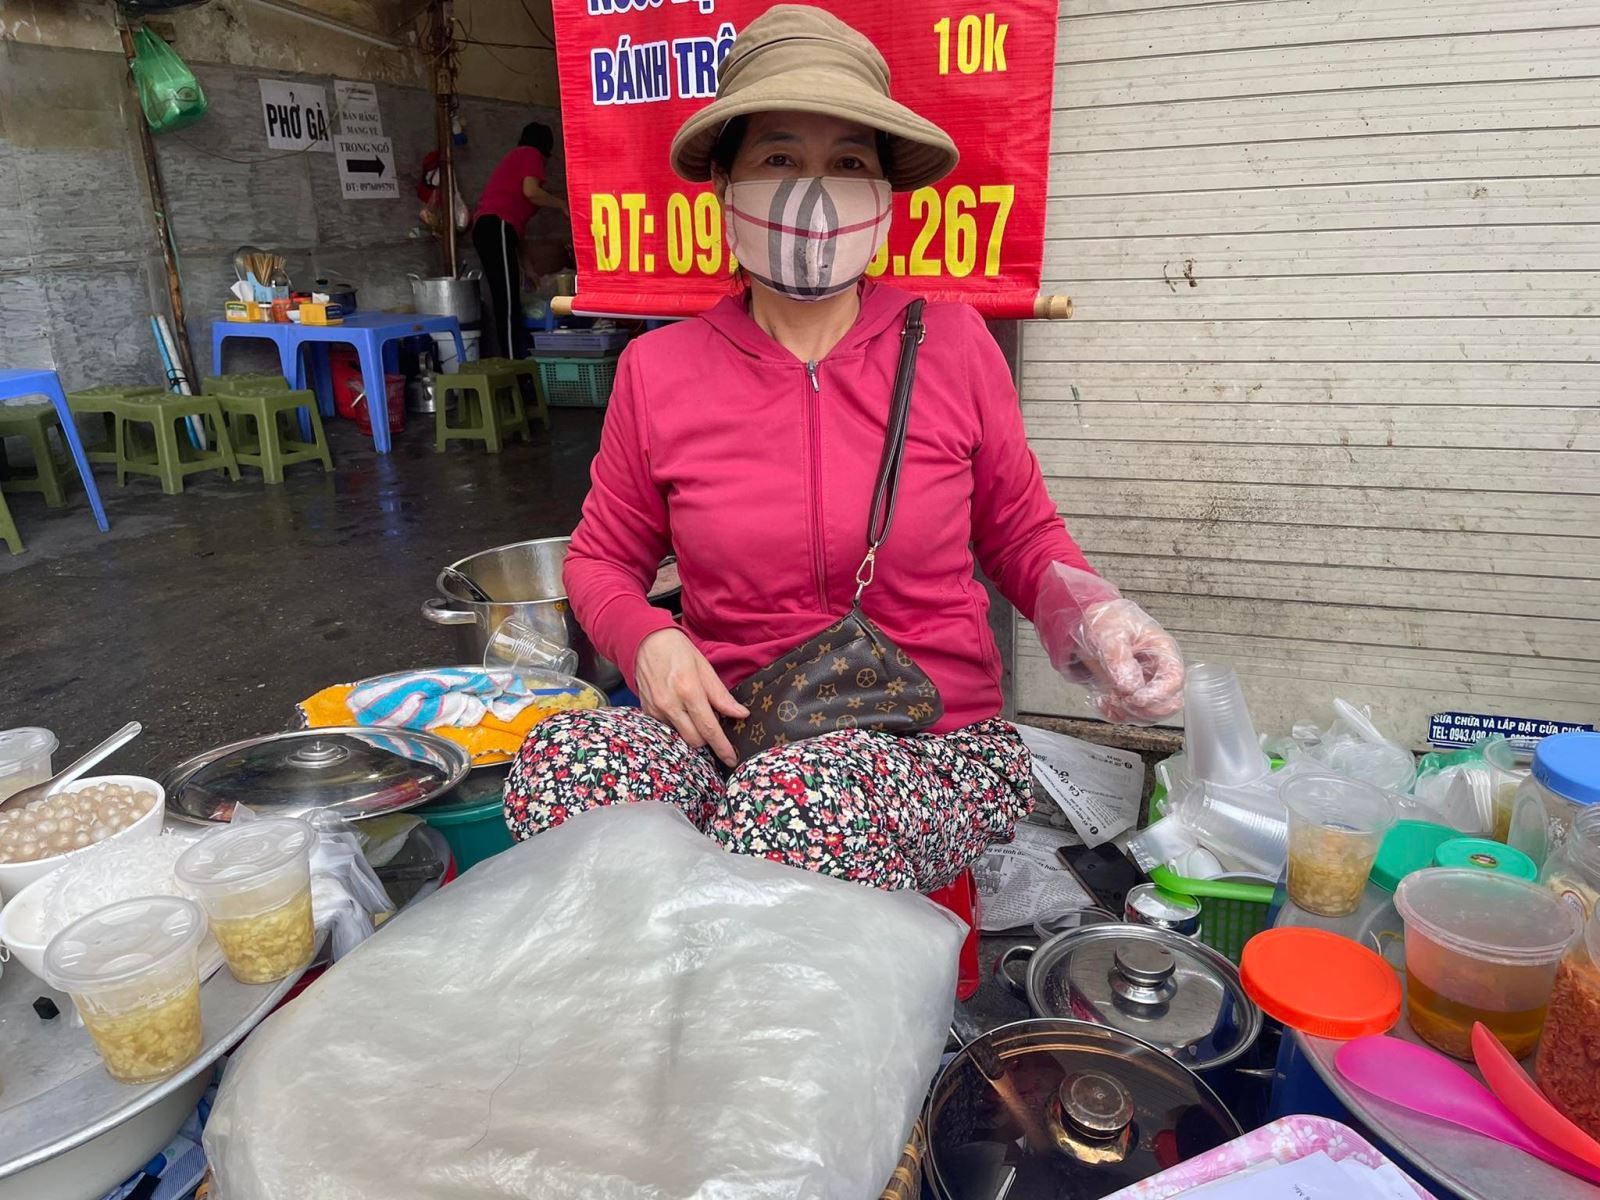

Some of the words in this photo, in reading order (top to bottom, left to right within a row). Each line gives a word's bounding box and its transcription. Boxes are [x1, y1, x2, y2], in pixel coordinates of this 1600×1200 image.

[934, 13, 1008, 75] 10k
[592, 36, 669, 103] BÁNH
[266, 91, 302, 139] PHỞ
[305, 102, 329, 141] GÀ
[339, 142, 370, 152] TRONG
[591, 193, 654, 272] ĐT:
[667, 191, 739, 275] 09
[1432, 725, 1448, 740] TEL:
[1454, 715, 1480, 727] CHỮA
[1482, 717, 1495, 729] VÀ
[1539, 721, 1559, 734] CỬA
